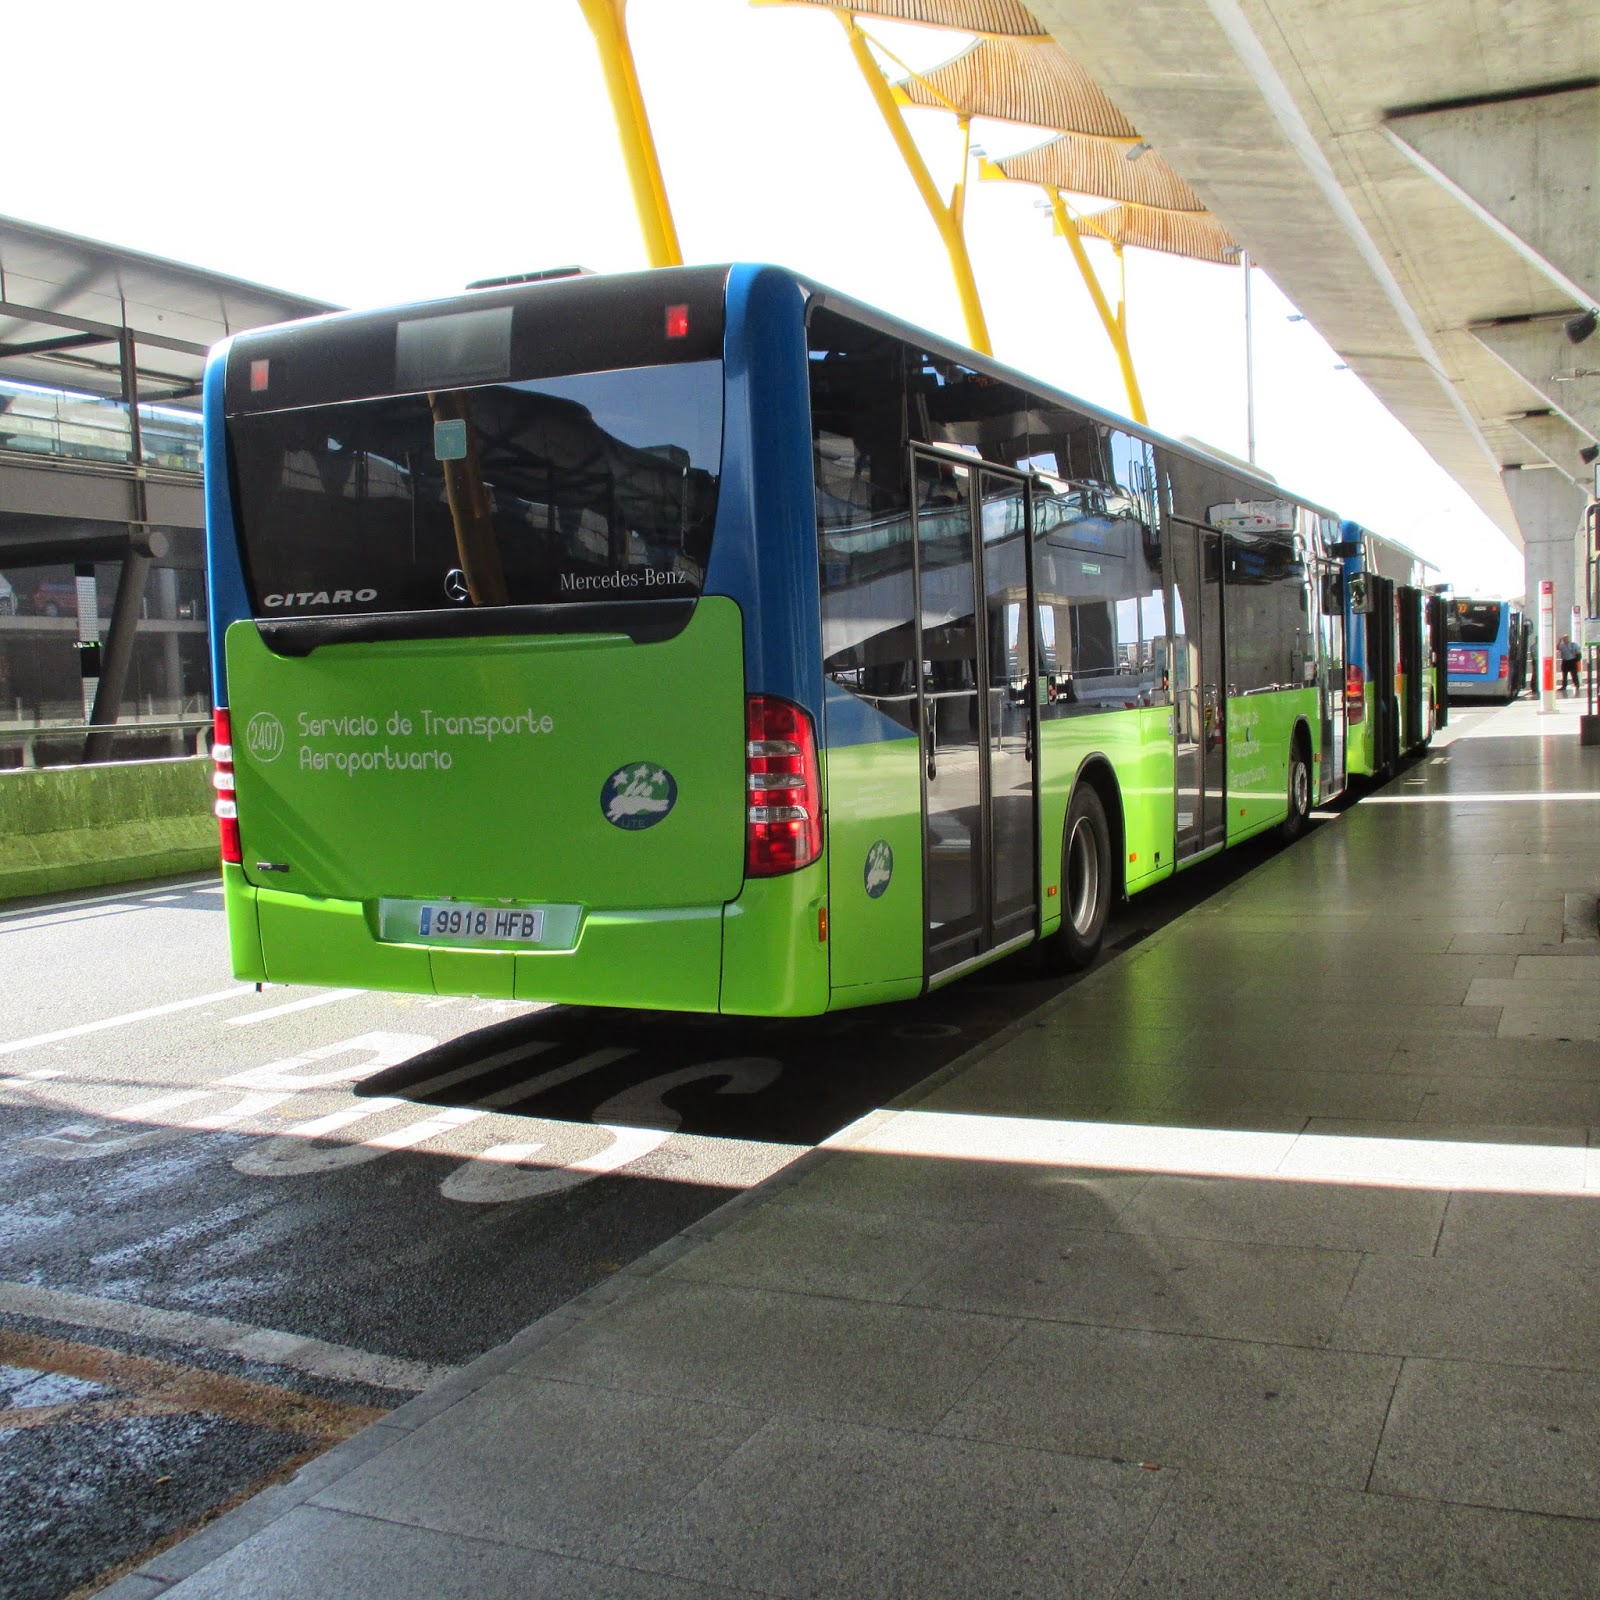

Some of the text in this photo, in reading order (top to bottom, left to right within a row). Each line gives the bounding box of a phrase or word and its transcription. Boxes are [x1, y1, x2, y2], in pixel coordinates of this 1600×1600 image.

[560, 568, 687, 590] Mercedes-Benz
[263, 588, 378, 607] CITARO
[250, 720, 279, 751] 2407
[298, 708, 553, 742] Servicio de Transporte
[300, 745, 452, 778] Aeroportuario
[436, 910, 488, 935] 9918
[494, 912, 535, 938] HFB
